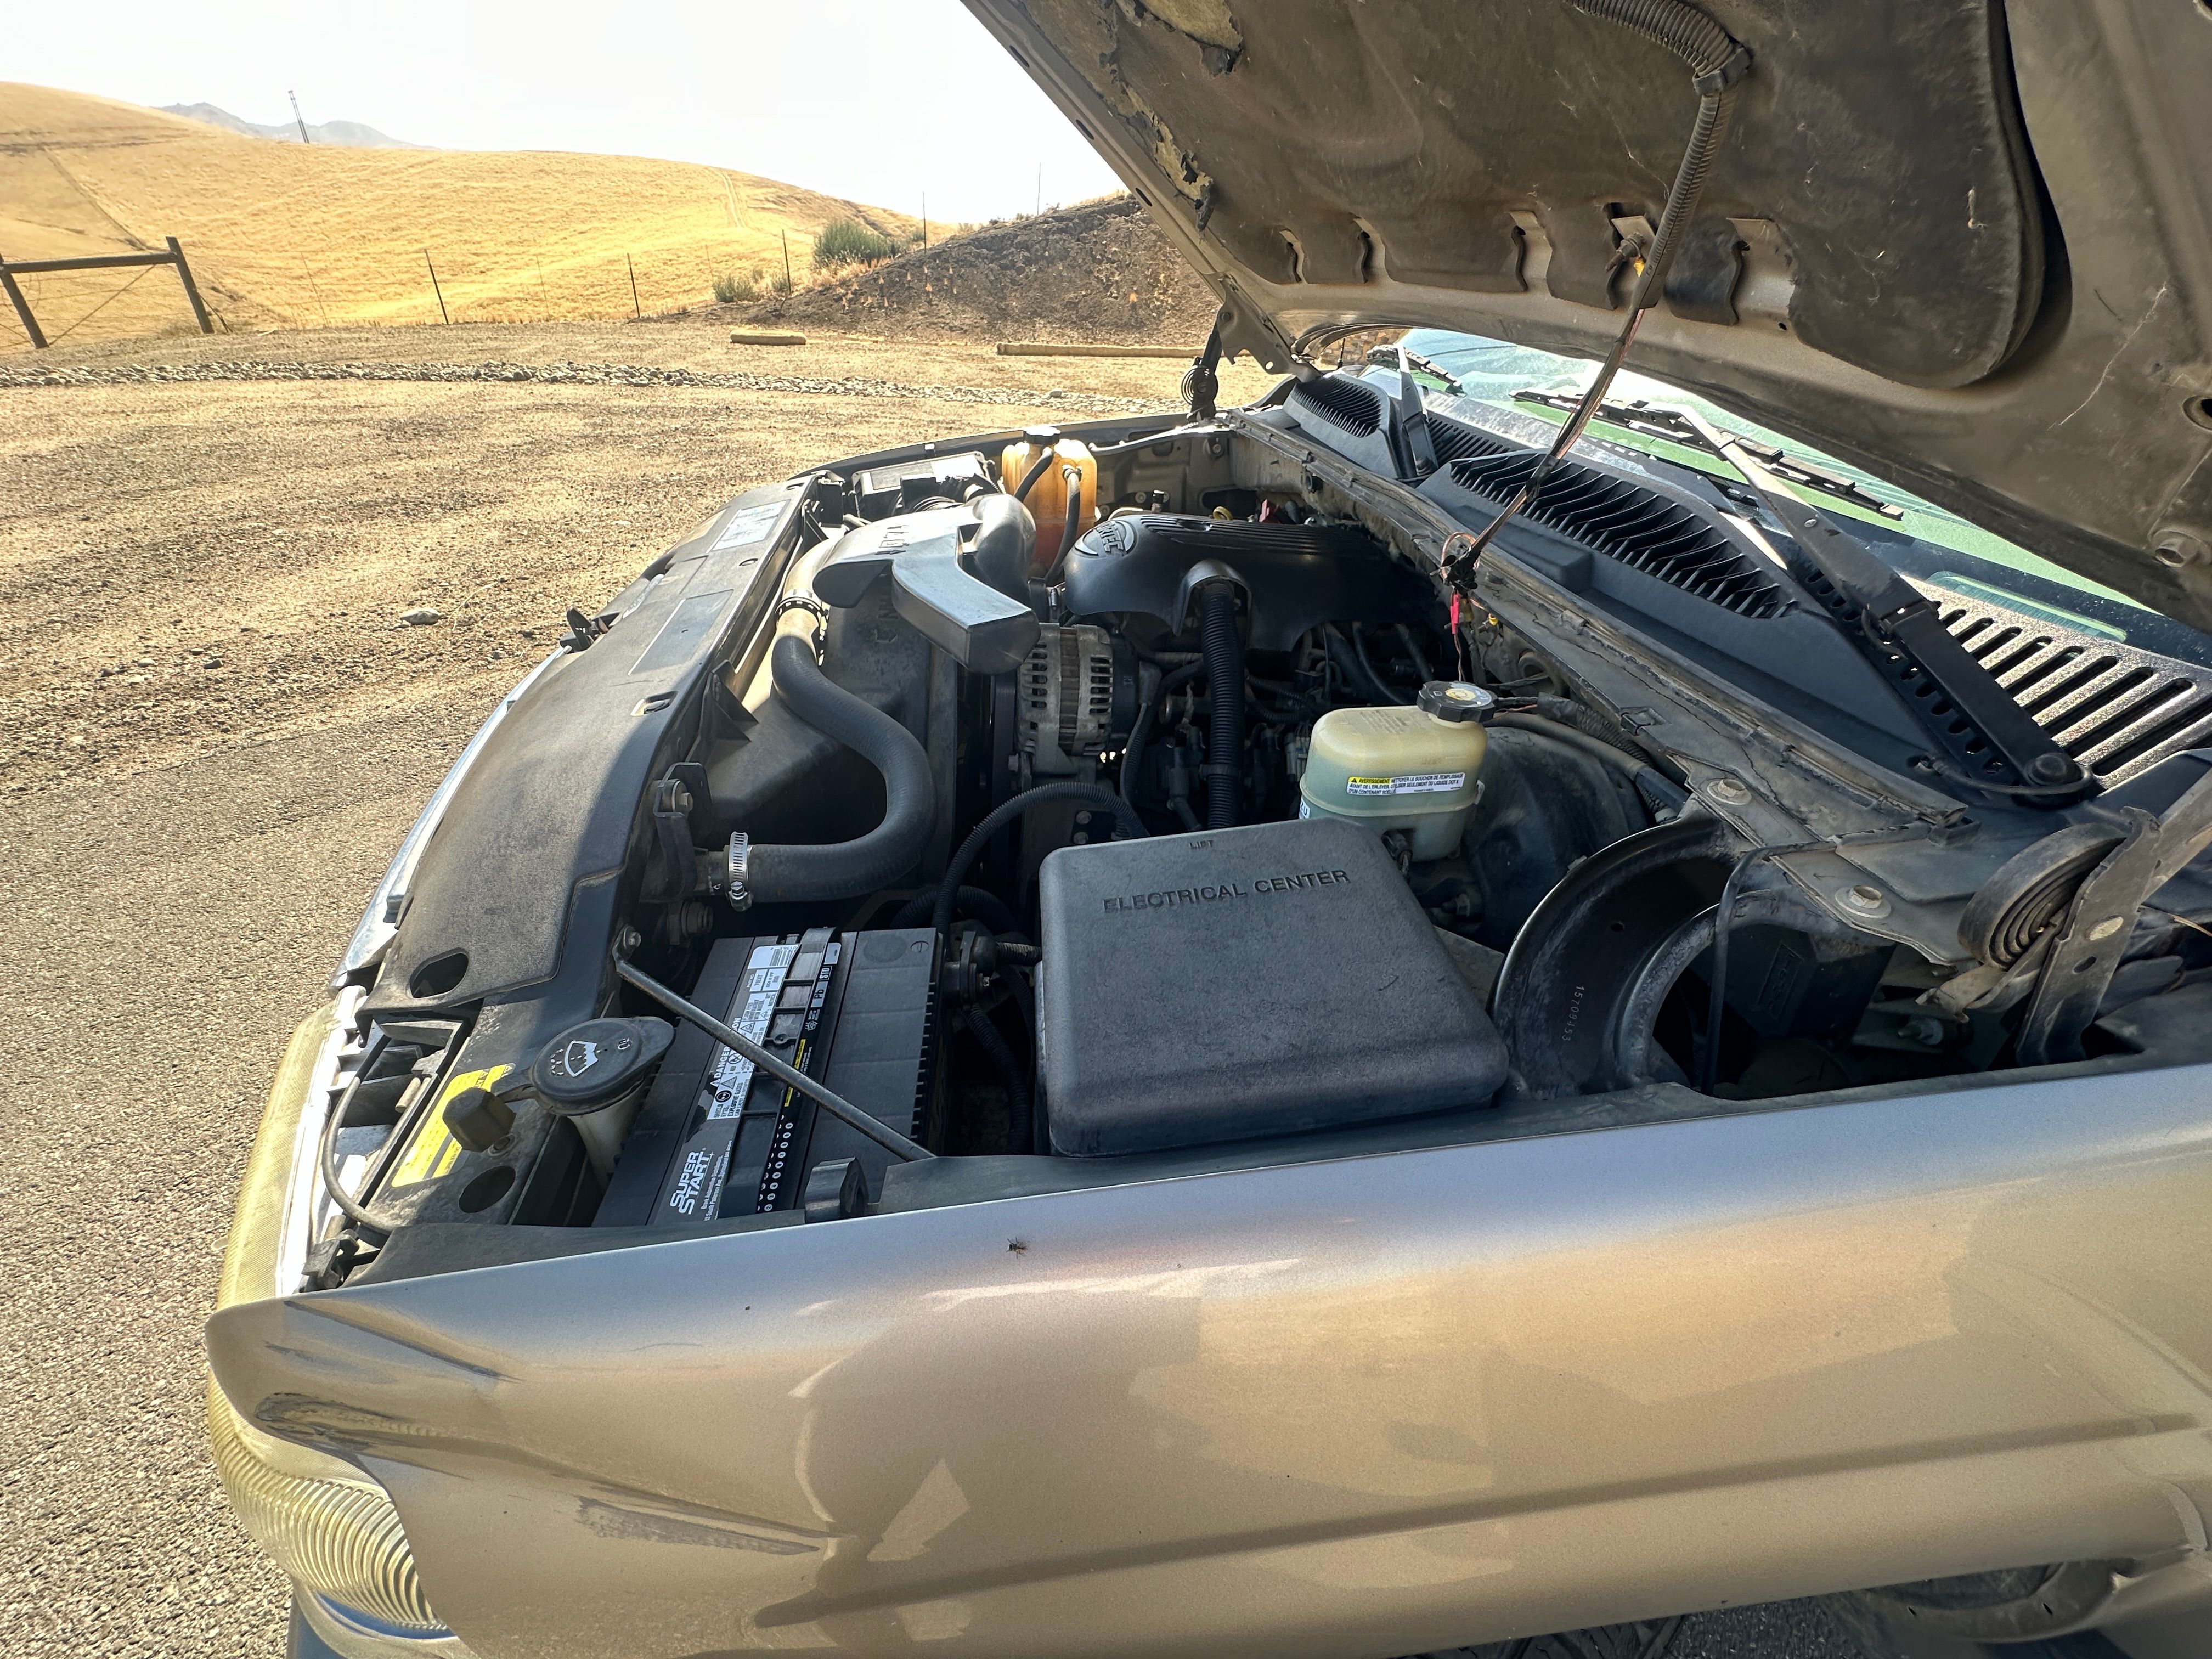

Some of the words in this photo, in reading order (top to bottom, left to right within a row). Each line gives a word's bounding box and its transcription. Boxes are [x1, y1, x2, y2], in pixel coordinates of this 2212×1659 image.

[1102, 882, 1248, 913] ELECTRICAL
[1253, 869, 1351, 894] CENTER
[814, 989, 825, 999] Pb
[669, 1150, 699, 1207] SUPER
[678, 1150, 710, 1215] START
